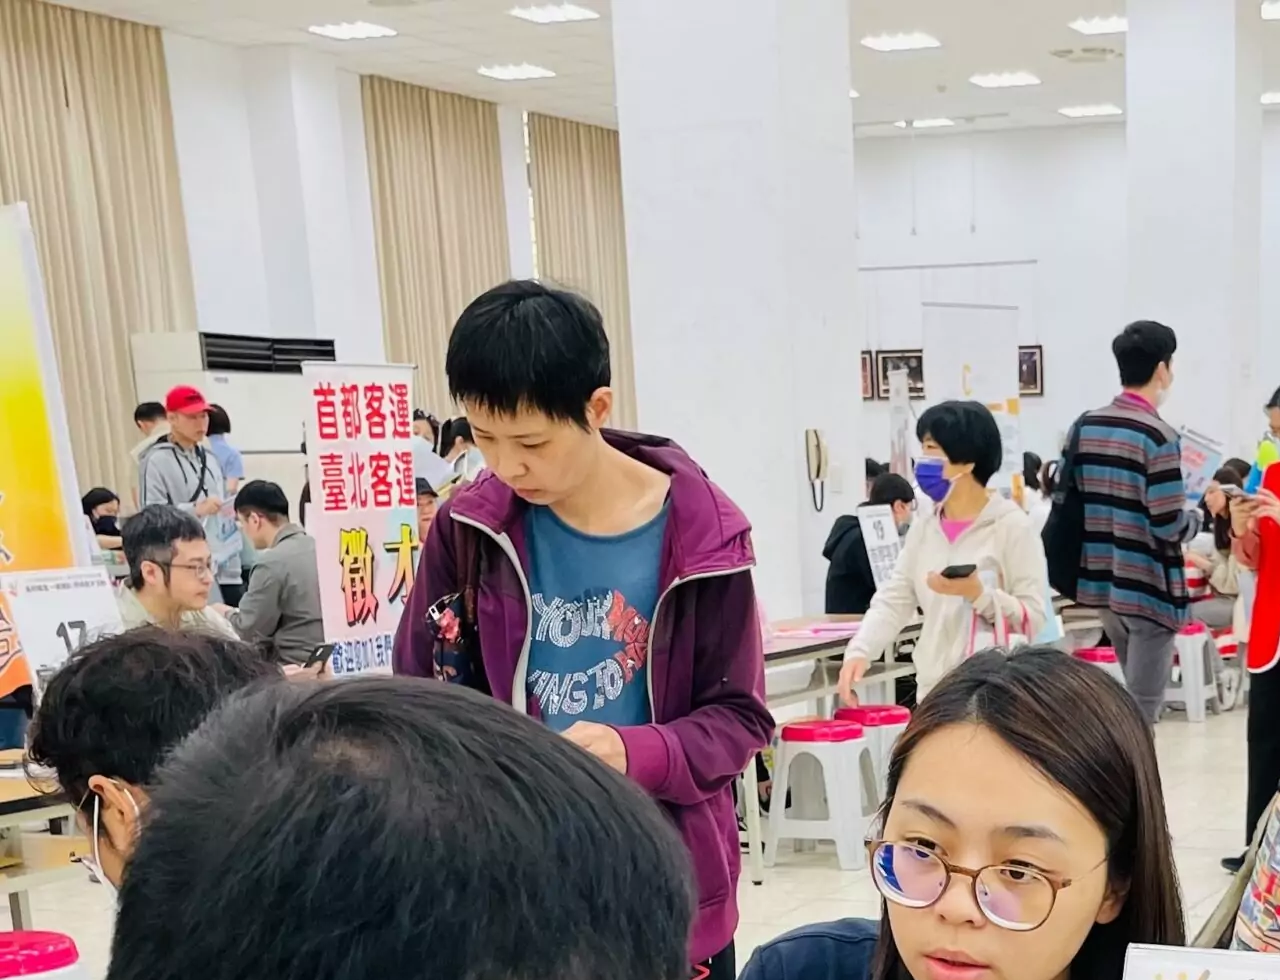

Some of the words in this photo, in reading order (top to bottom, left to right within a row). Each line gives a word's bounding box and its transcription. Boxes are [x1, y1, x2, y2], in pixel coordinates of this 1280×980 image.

[313, 382, 411, 440] 首都客運
[320, 451, 415, 511] 臺北客運
[339, 523, 418, 628] 徵才
[56, 620, 87, 658] 17
[532, 590, 613, 648] YOUR
